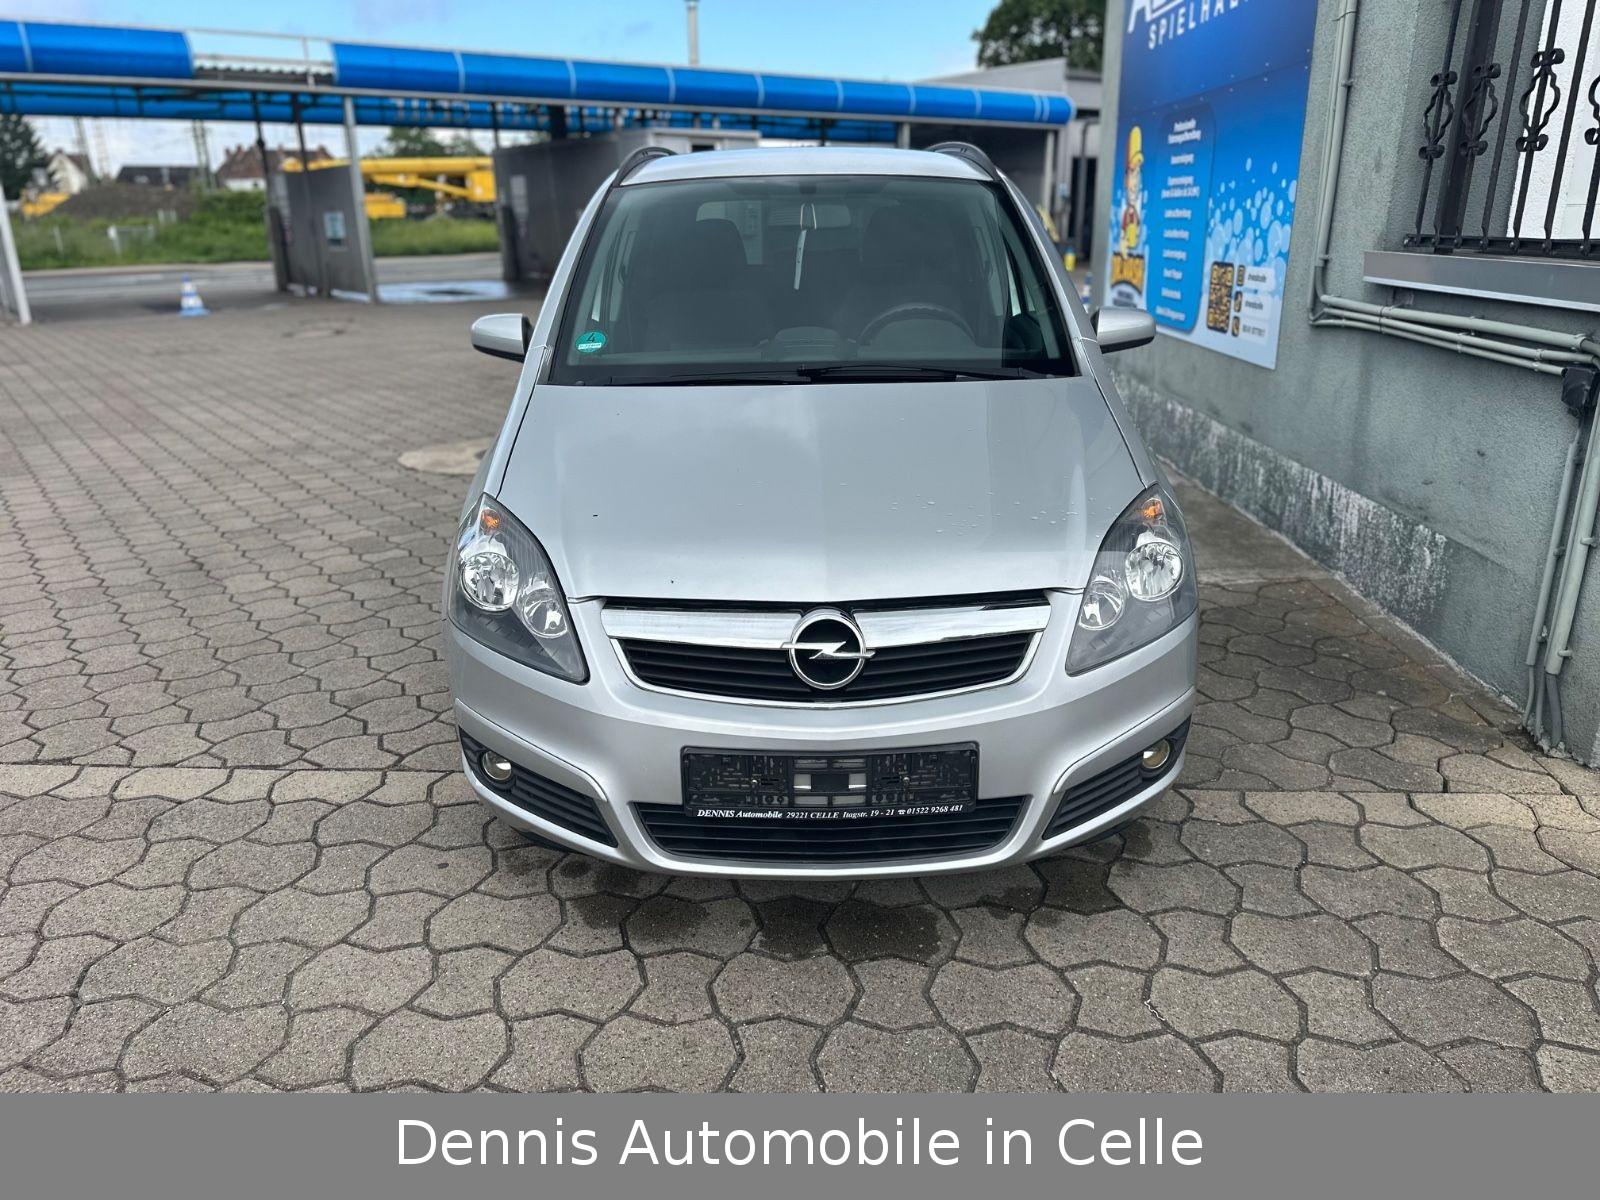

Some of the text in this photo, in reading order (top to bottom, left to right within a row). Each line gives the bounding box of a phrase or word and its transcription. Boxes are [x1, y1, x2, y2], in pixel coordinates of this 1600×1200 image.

[1148, 0, 1249, 50] SPIELHA
[586, 332, 595, 342] 4
[697, 809, 735, 818] DENNIS
[735, 810, 783, 819] Automobile
[786, 811, 808, 819] 29221
[810, 811, 839, 819] CELLE
[870, 809, 880, 817] 19
[906, 806, 929, 815] 01522
[931, 805, 949, 813] 9268
[949, 804, 963, 812] 481
